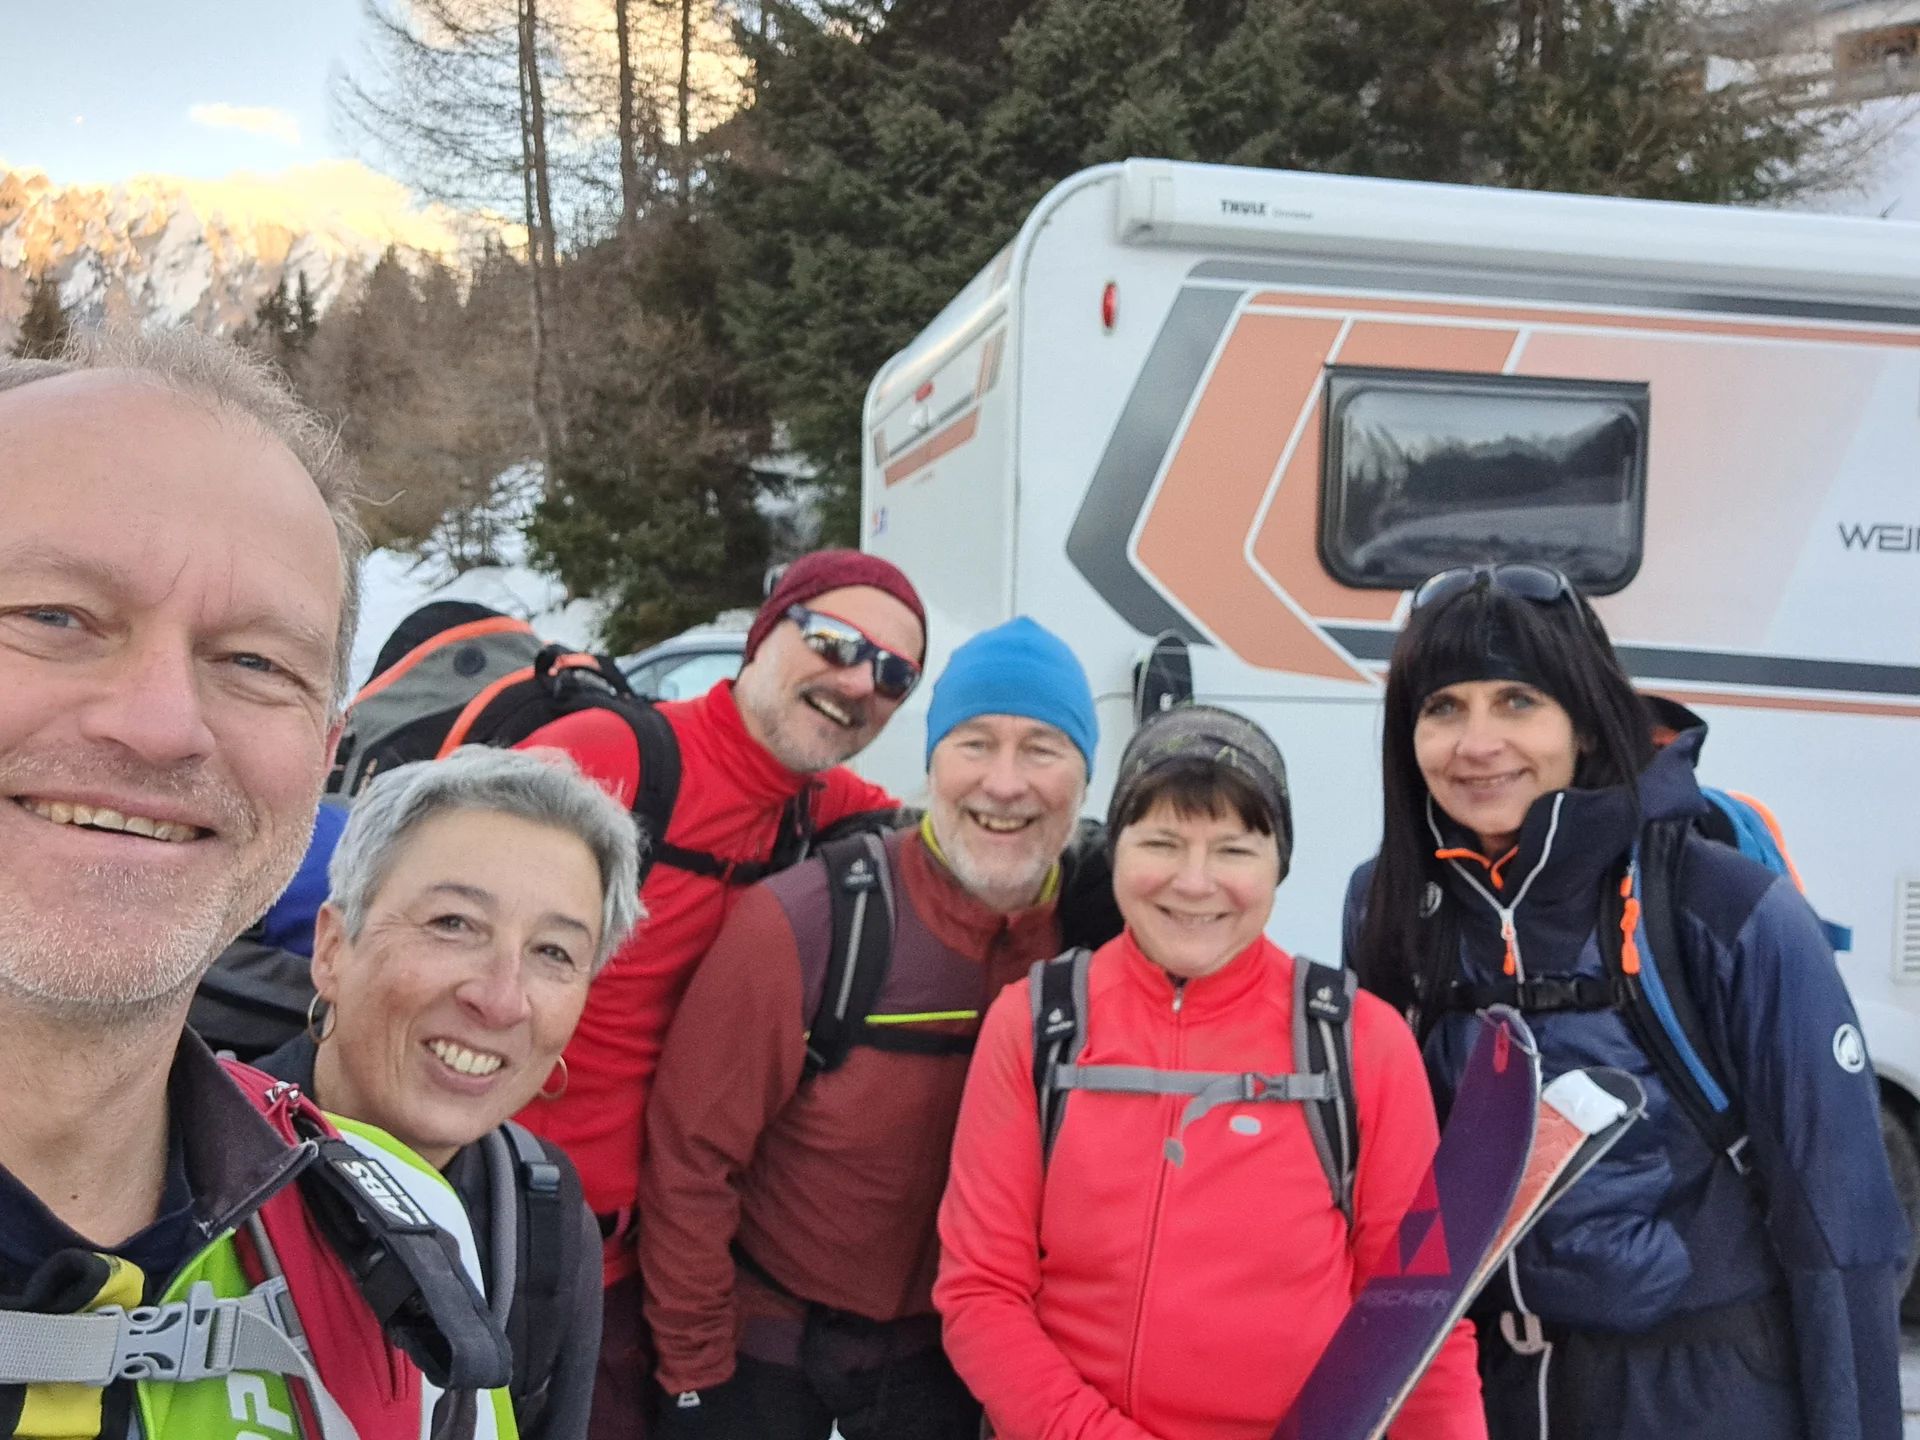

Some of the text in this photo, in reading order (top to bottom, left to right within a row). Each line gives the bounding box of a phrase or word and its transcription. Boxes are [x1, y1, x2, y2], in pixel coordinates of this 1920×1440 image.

[1221, 199, 1266, 216] THULE
[1838, 523, 1920, 551] WEI
[341, 1160, 415, 1226] ABS
